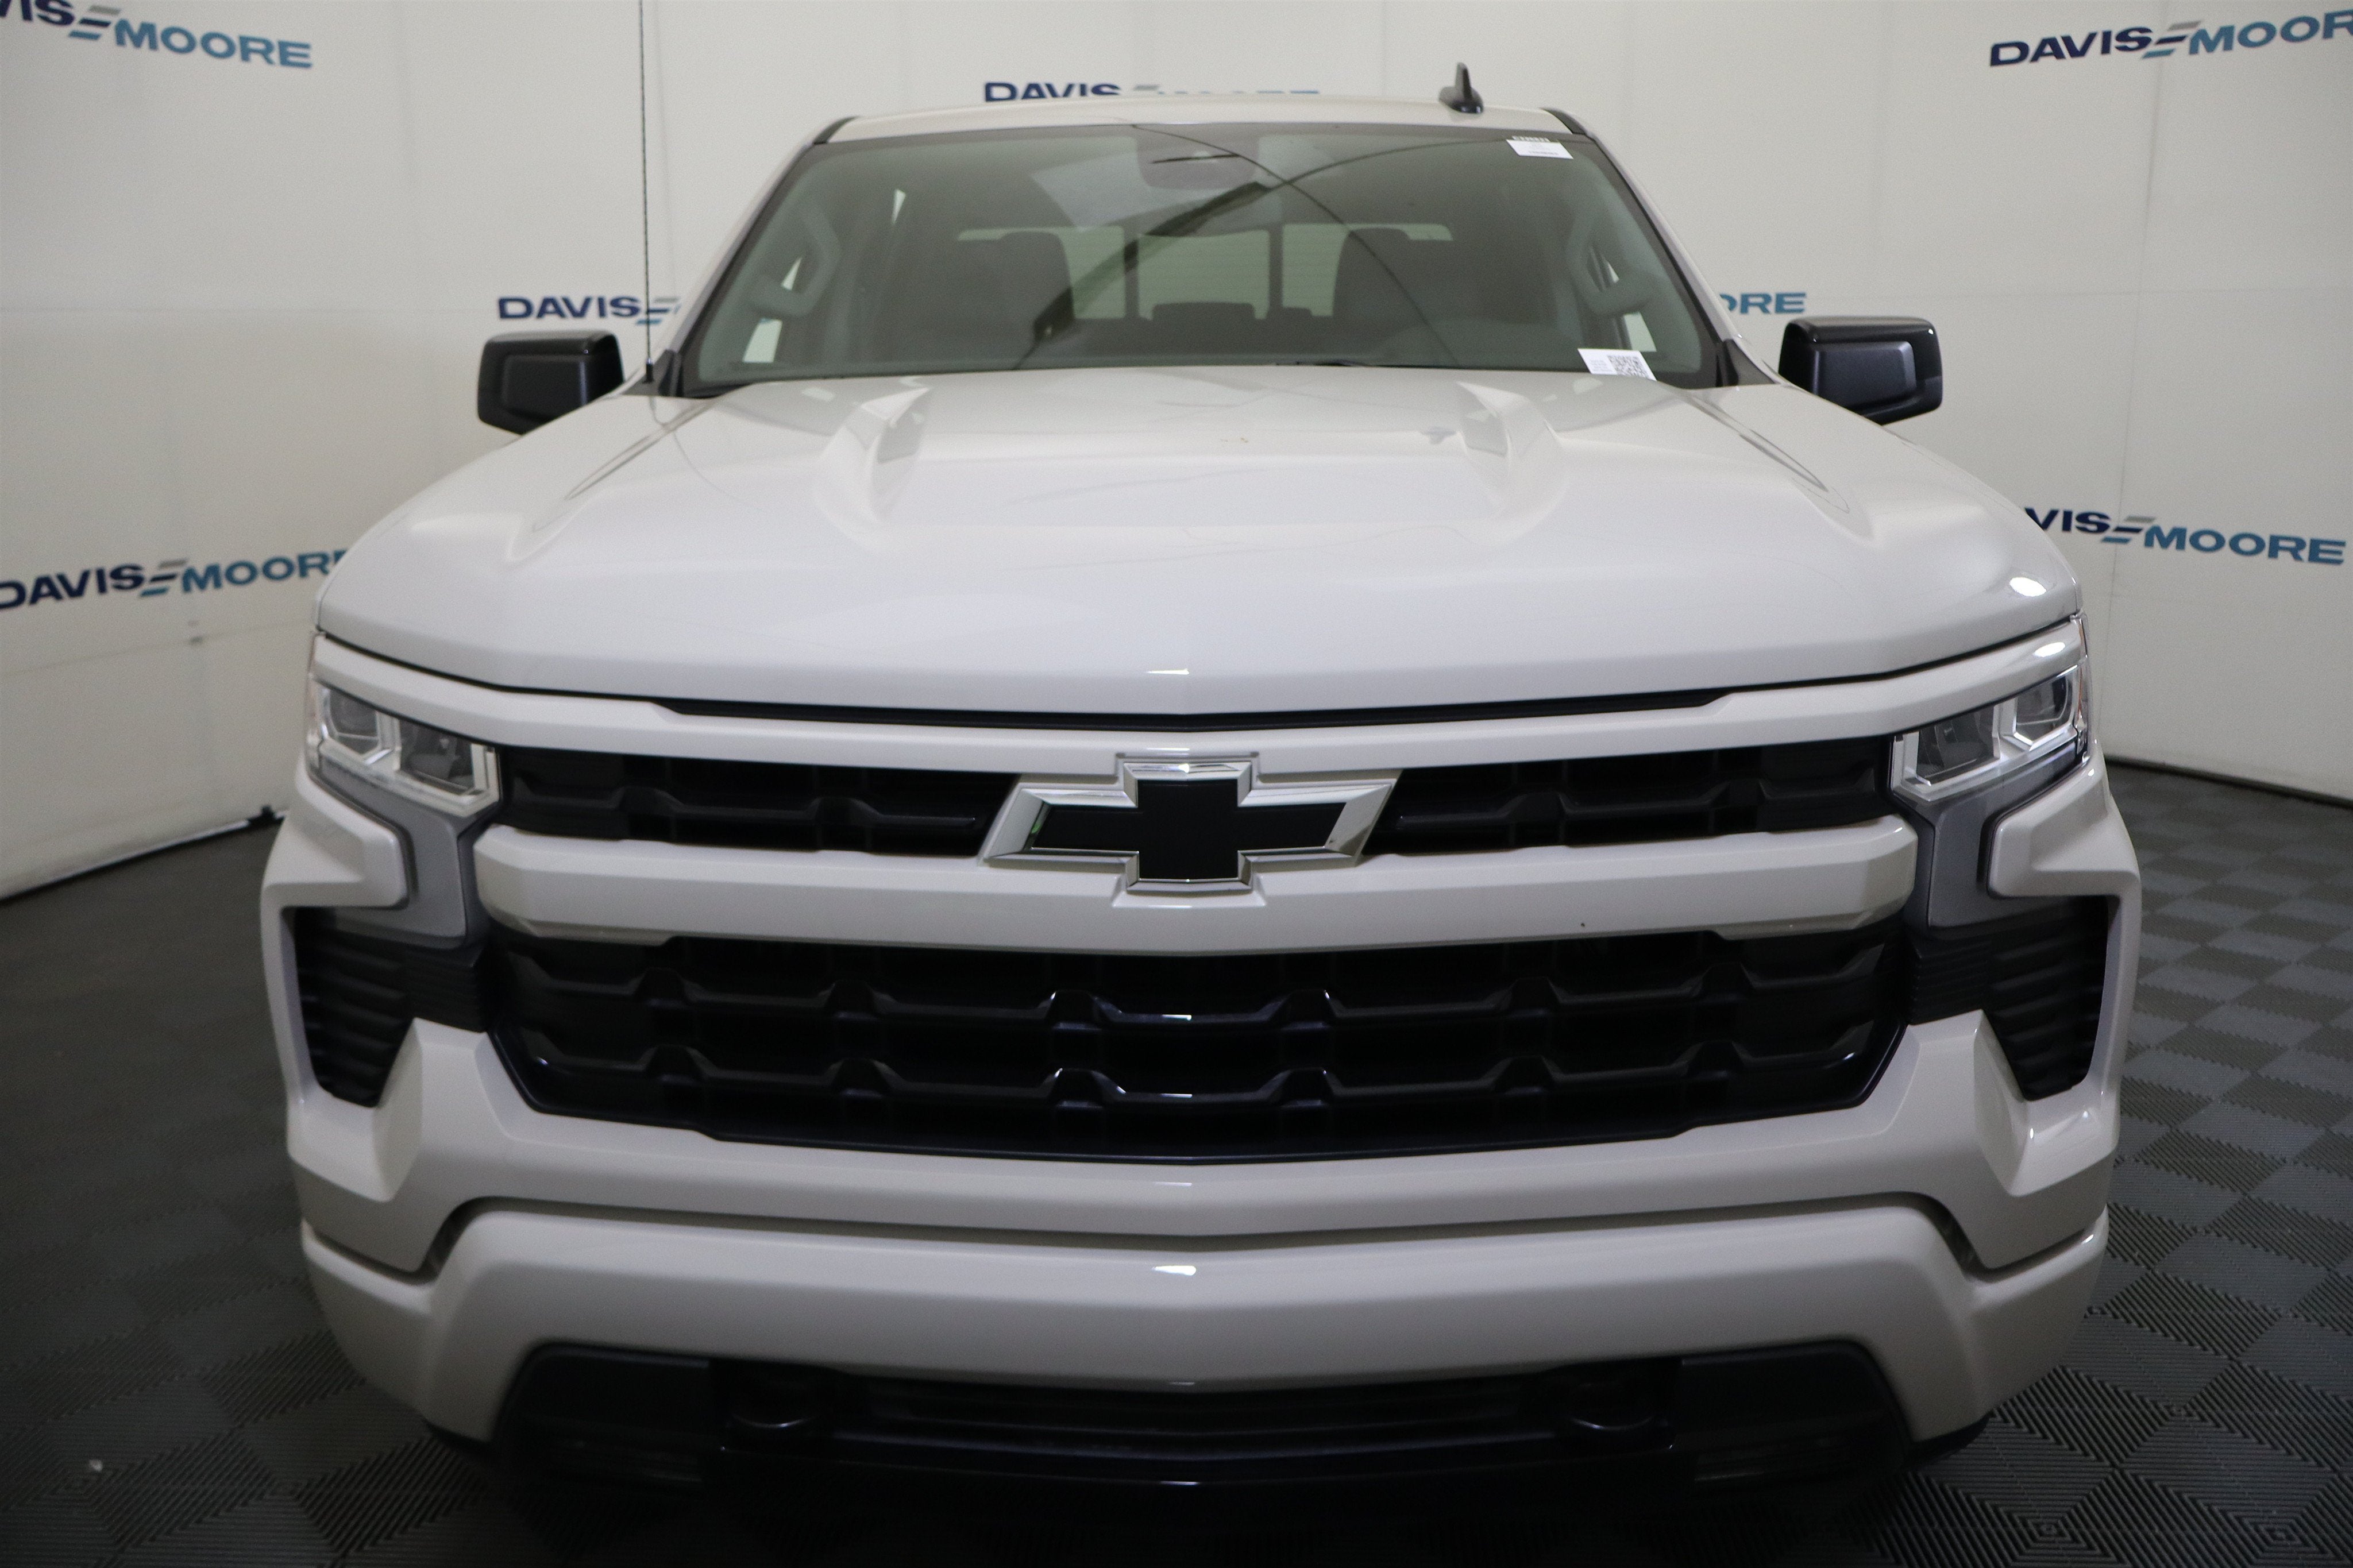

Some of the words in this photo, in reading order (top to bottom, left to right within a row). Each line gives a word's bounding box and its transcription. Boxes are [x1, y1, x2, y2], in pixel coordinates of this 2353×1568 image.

[114, 19, 312, 68] MOORE
[1990, 27, 2152, 66] DAVIS
[498, 296, 641, 319] DAVIS
[2144, 526, 2346, 565] MOORE
[0, 565, 144, 609] DAVIS
[182, 550, 346, 593] MOOR
